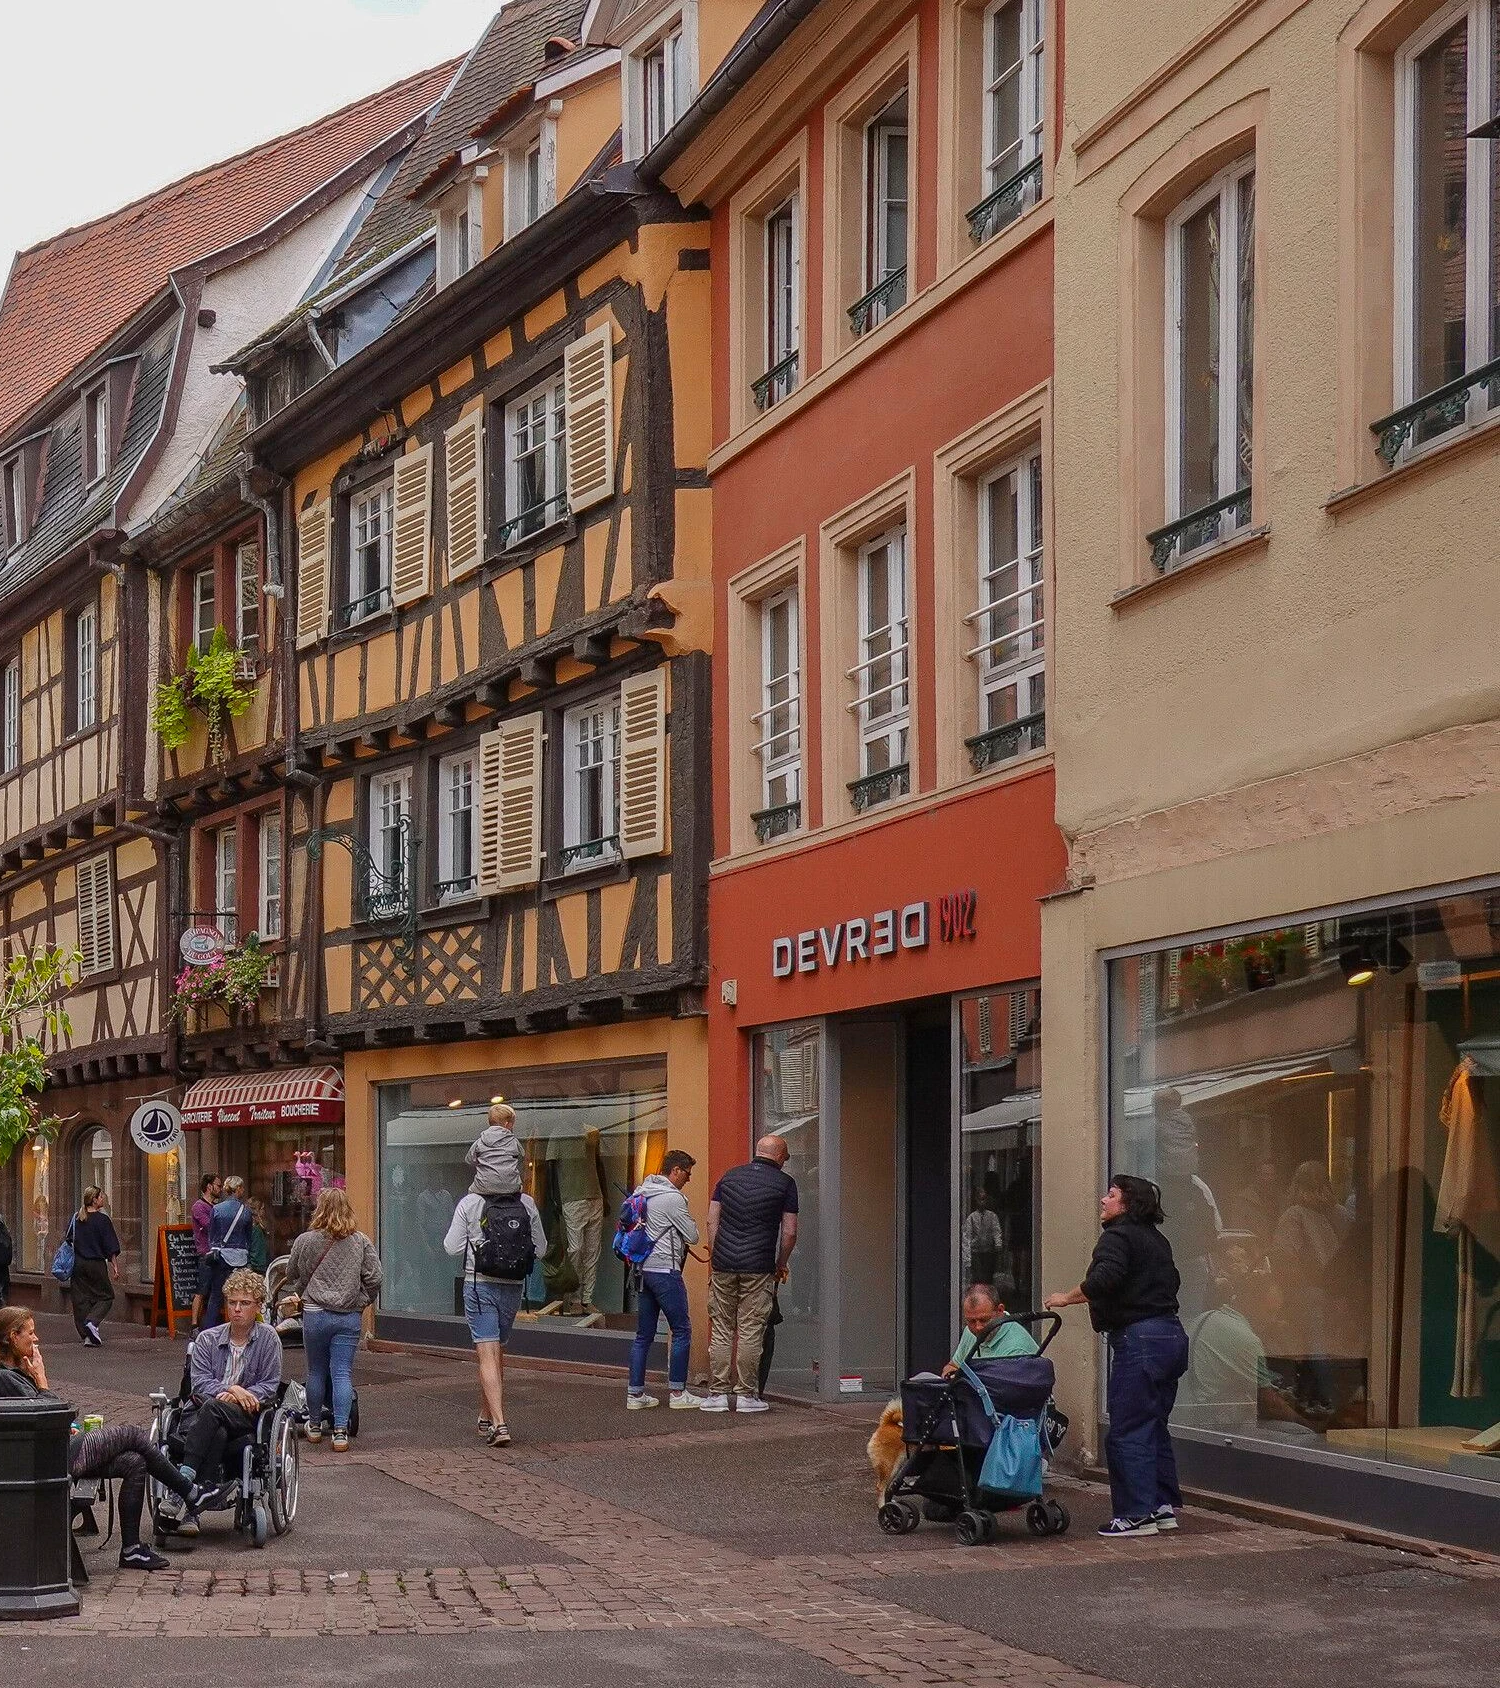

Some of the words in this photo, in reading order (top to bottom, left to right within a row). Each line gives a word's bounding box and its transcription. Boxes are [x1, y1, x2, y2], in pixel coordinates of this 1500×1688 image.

[773, 901, 930, 978] DEVRED
[181, 1111, 213, 1124] HARCUTERIE
[217, 1108, 241, 1123] Vincent
[281, 1103, 320, 1117] BOUCHERIE
[136, 1132, 154, 1148] PETIT
[156, 1128, 180, 1148] BATEAU
